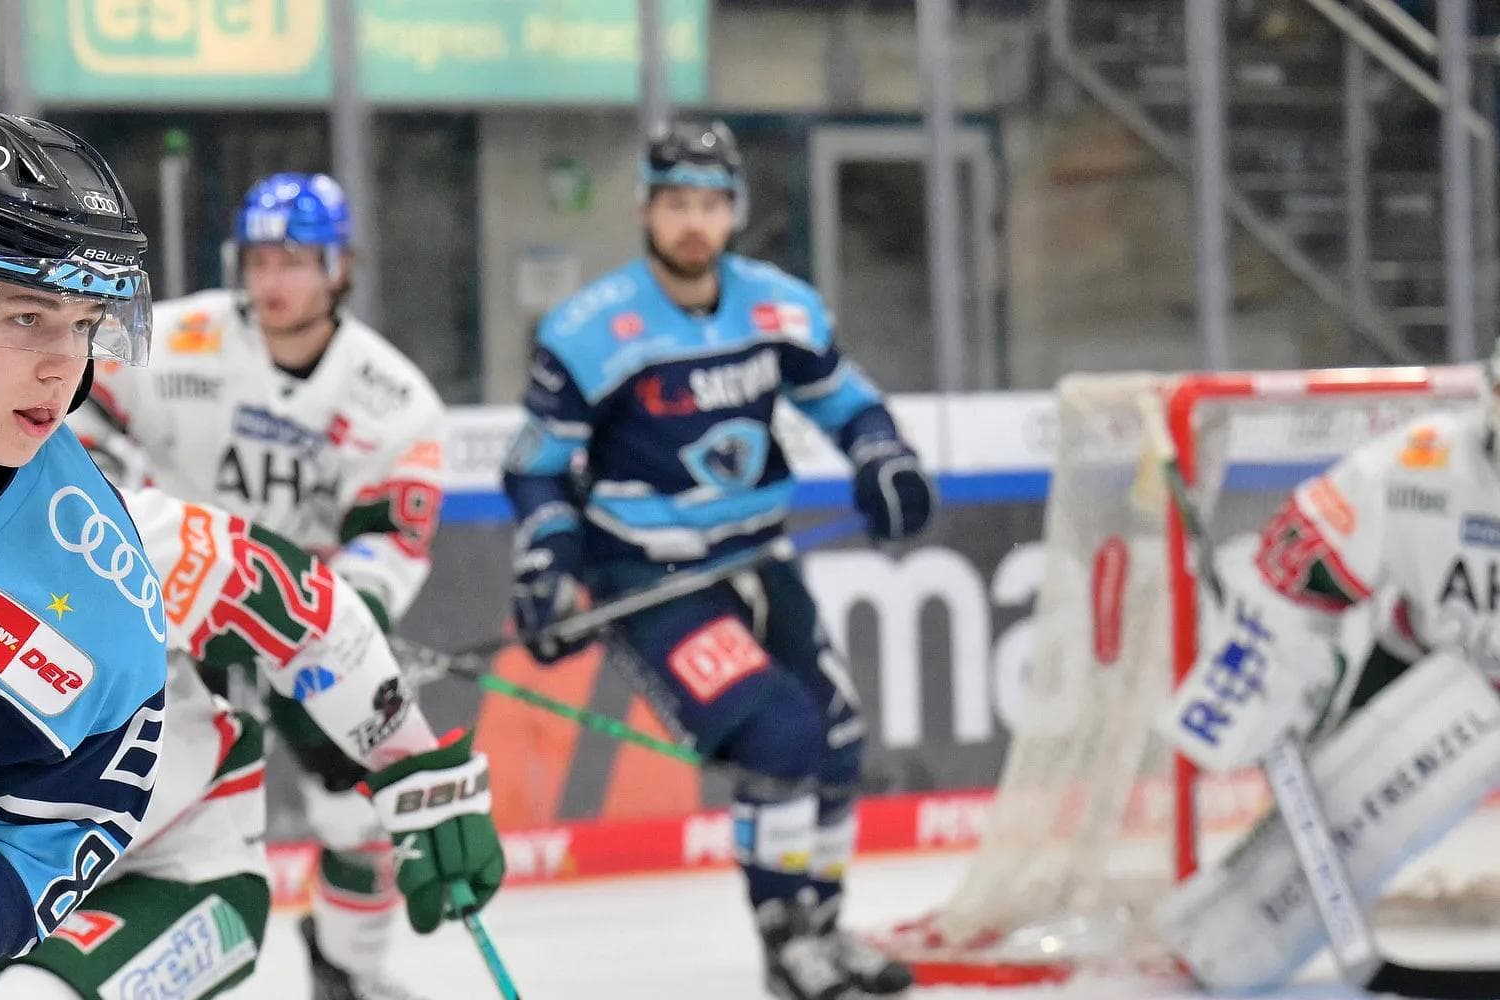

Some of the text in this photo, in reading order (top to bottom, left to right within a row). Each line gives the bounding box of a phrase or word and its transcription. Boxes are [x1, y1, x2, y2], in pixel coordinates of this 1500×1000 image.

[83, 248, 135, 264] BAUER
[209, 533, 339, 669] 12
[395, 770, 489, 816] BAU
